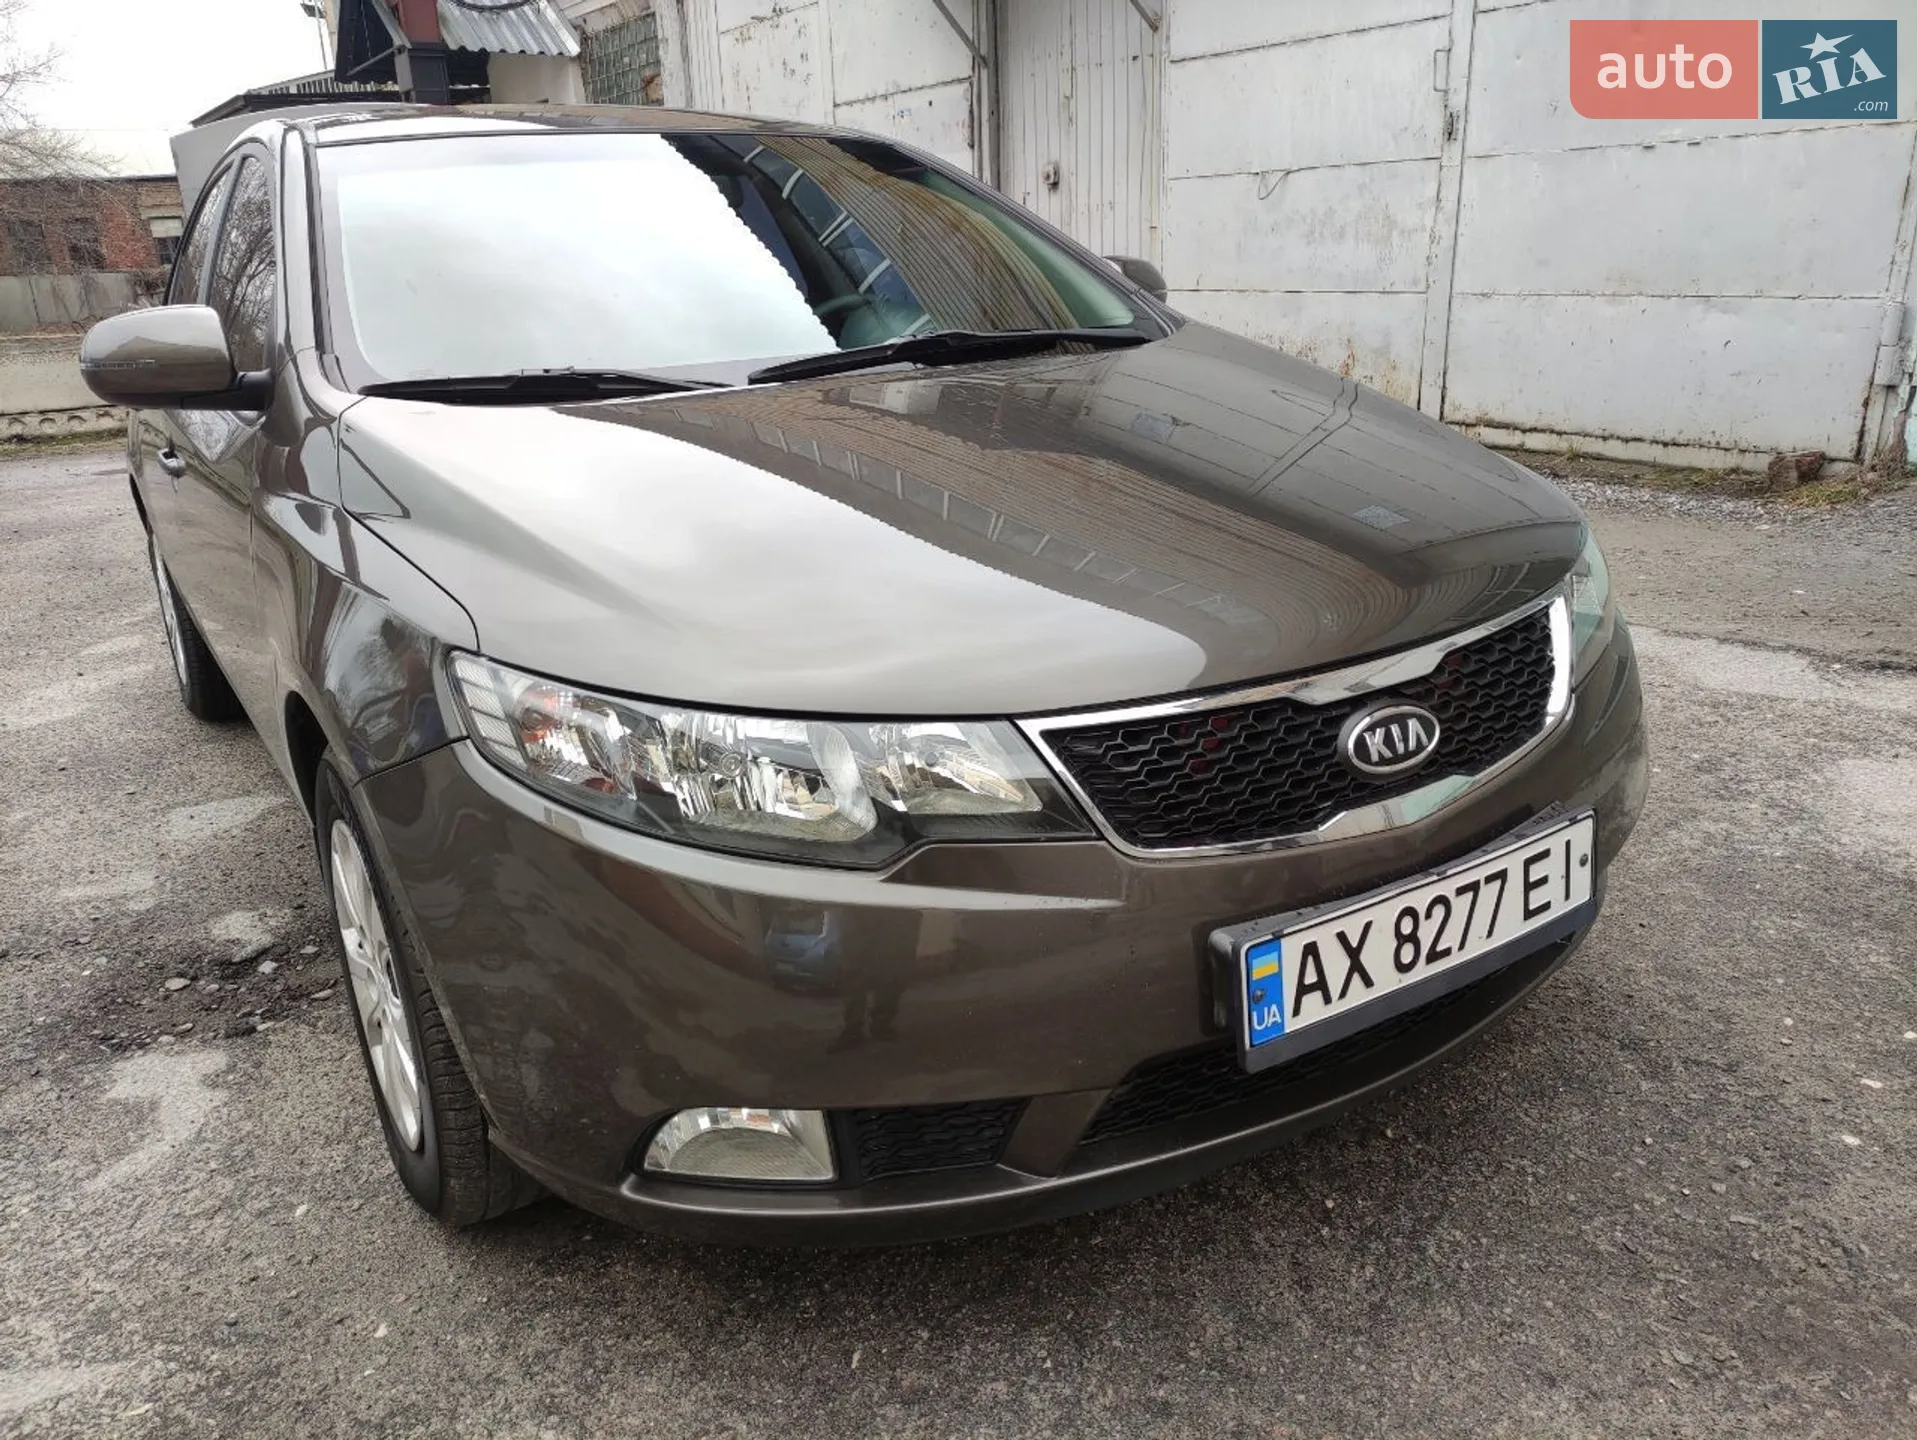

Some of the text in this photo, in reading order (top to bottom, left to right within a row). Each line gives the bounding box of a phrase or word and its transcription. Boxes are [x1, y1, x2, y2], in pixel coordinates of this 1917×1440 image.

[1363, 717, 1429, 763] KIA
[1291, 920, 1375, 1018] AX
[1393, 867, 1508, 974] 8277
[1252, 1004, 1282, 1031] UA
